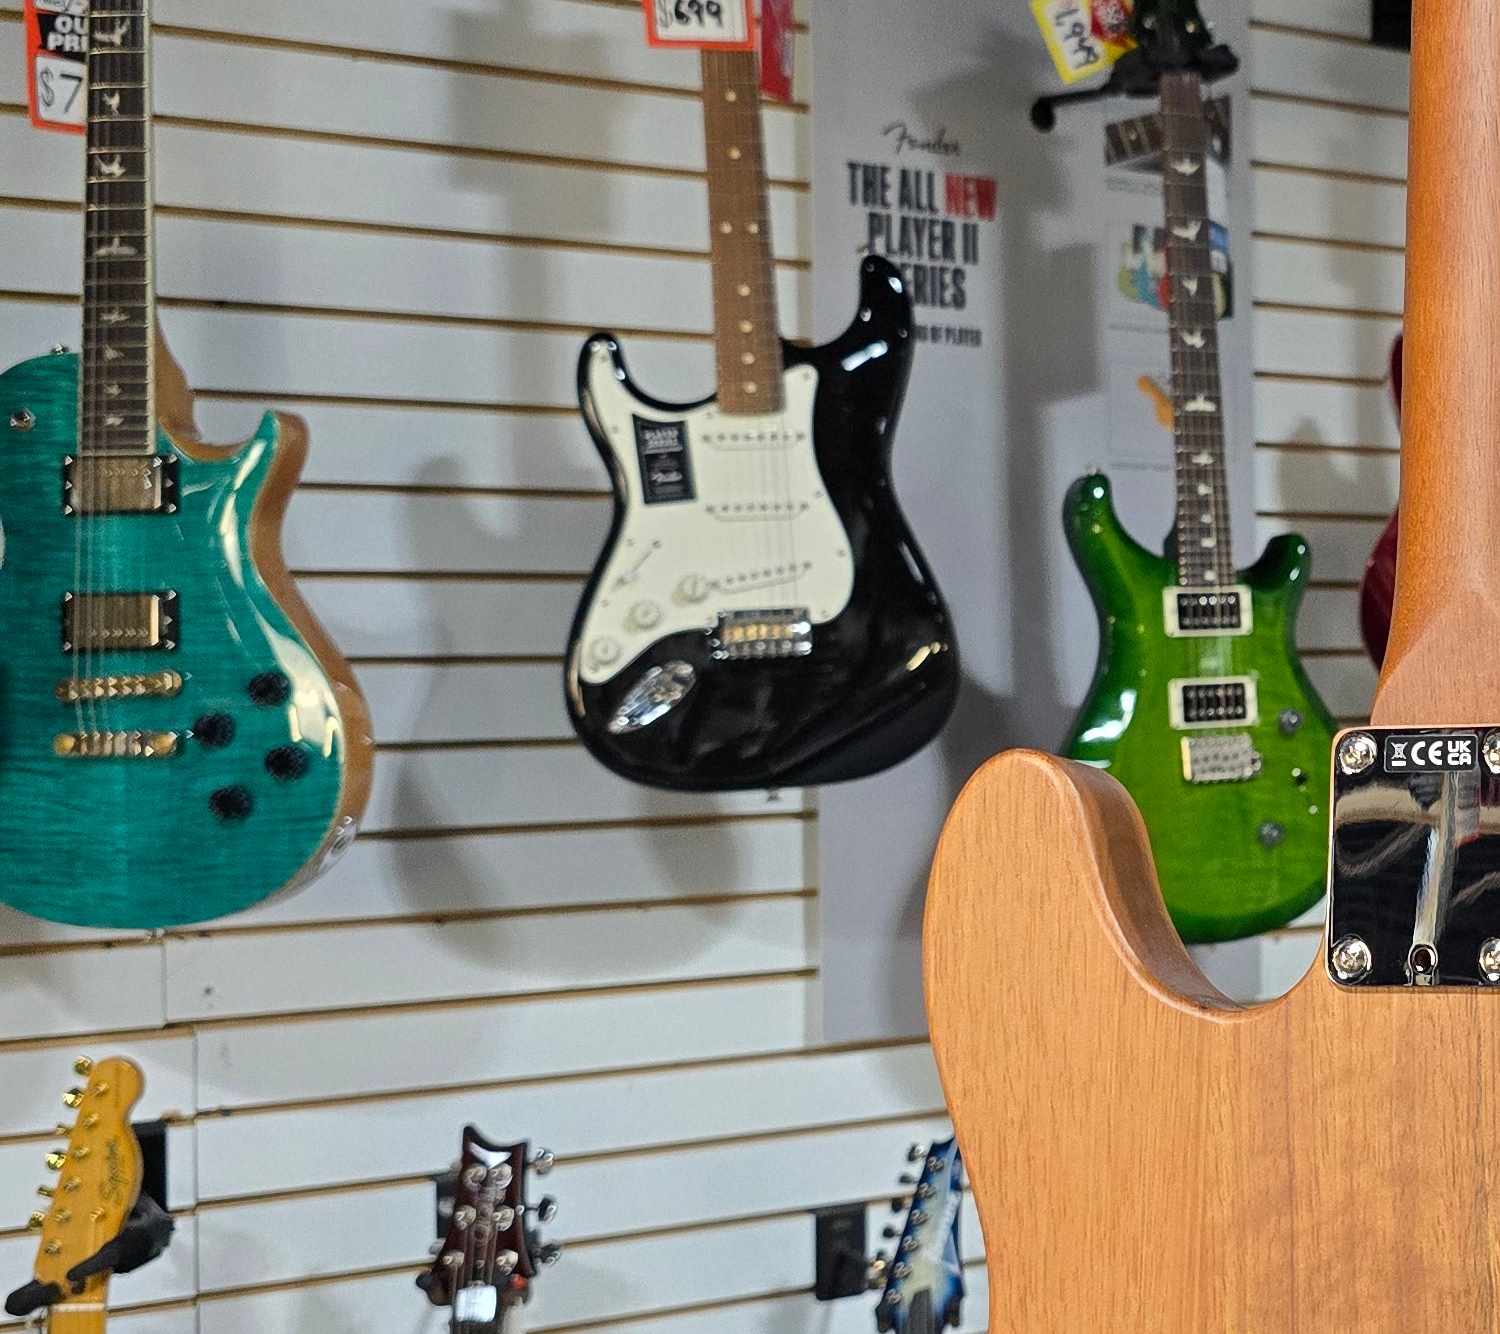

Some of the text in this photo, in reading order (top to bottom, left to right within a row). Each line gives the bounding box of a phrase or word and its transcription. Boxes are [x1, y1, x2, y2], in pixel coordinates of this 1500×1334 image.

[54, 13, 88, 36] OU
[47, 30, 88, 52] PRI
[847, 160, 997, 222] THE ALL NEW
[867, 212, 956, 264] PLAYER
[900, 263, 967, 311] ERIES
[1411, 740, 1443, 766] CE
[1447, 740, 1472, 754] UK
[1447, 753, 1472, 766] CA
